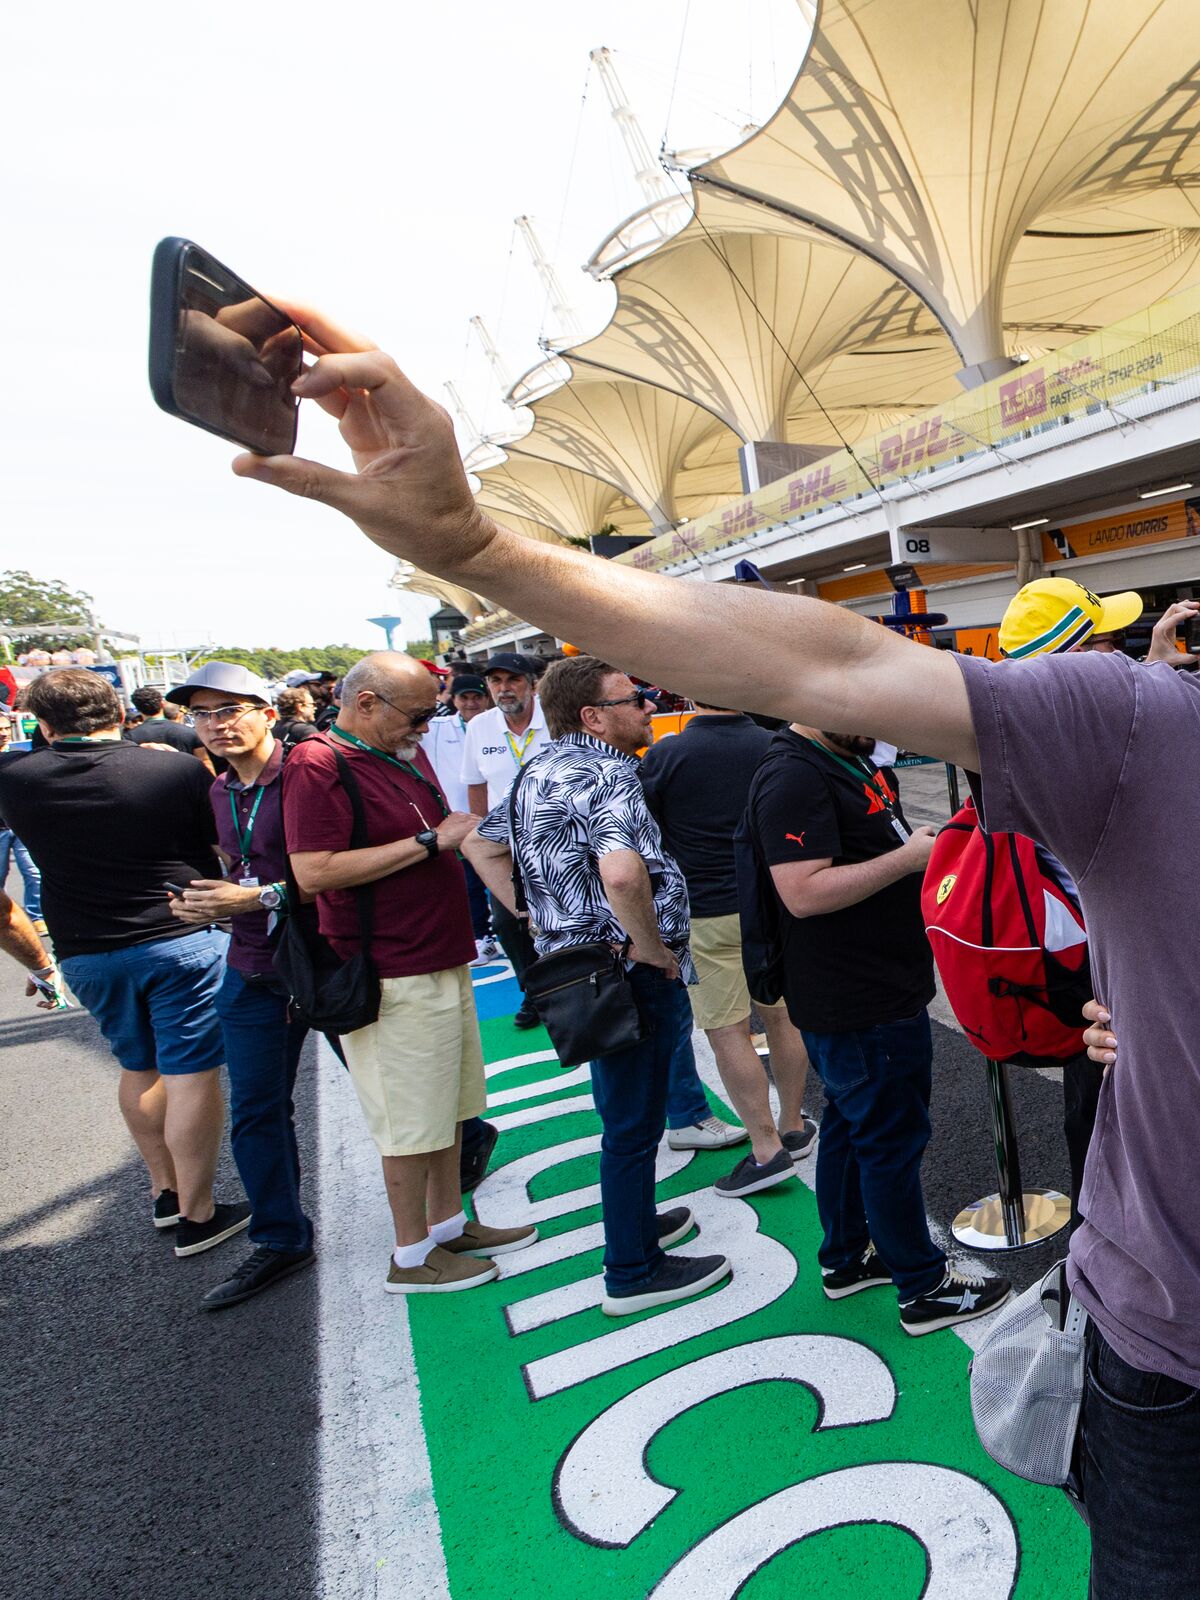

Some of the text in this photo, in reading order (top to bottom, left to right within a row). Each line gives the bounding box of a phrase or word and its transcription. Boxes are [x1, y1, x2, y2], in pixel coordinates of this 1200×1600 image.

[1107, 366, 1134, 386] STOP
[1135, 353, 1164, 375] 2024
[879, 415, 950, 475] DHL
[788, 465, 836, 512] DHL
[720, 500, 758, 537] DHL
[1054, 515, 1168, 559] 4 LANDO NORRIS
[906, 539, 930, 553] 08
